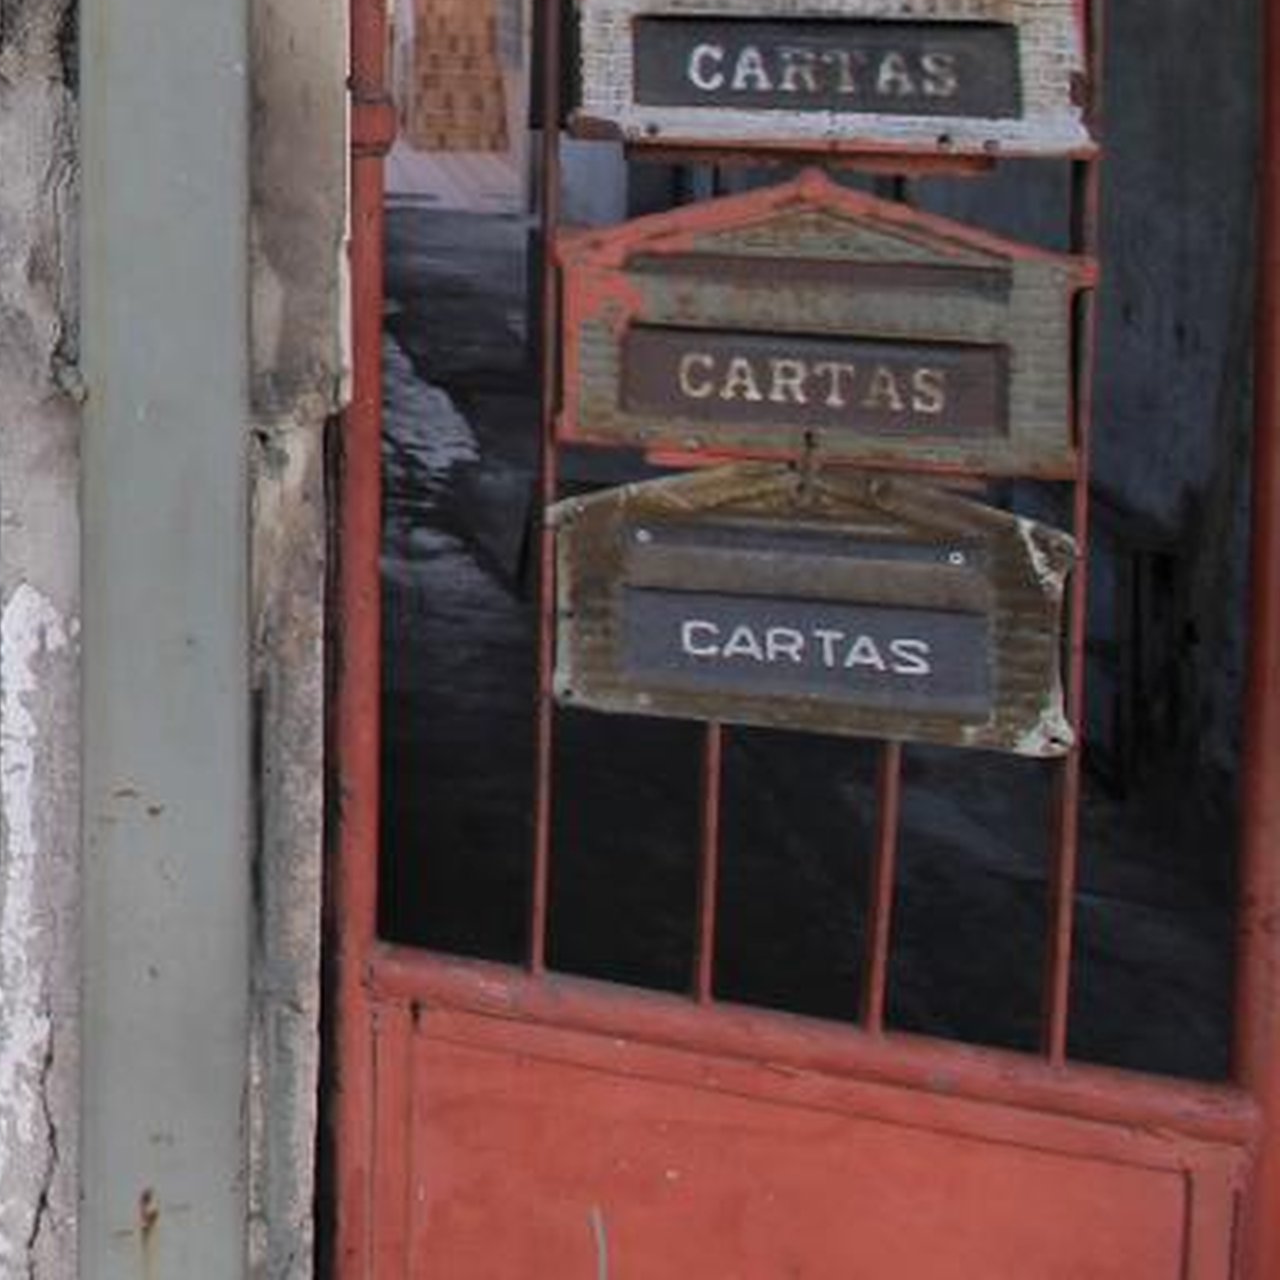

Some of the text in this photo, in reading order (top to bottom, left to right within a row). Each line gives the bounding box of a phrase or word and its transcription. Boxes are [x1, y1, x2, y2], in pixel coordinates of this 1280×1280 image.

[688, 42, 959, 97] CARTAS
[679, 353, 944, 413] CARTAS
[681, 620, 932, 674] CARTAS
